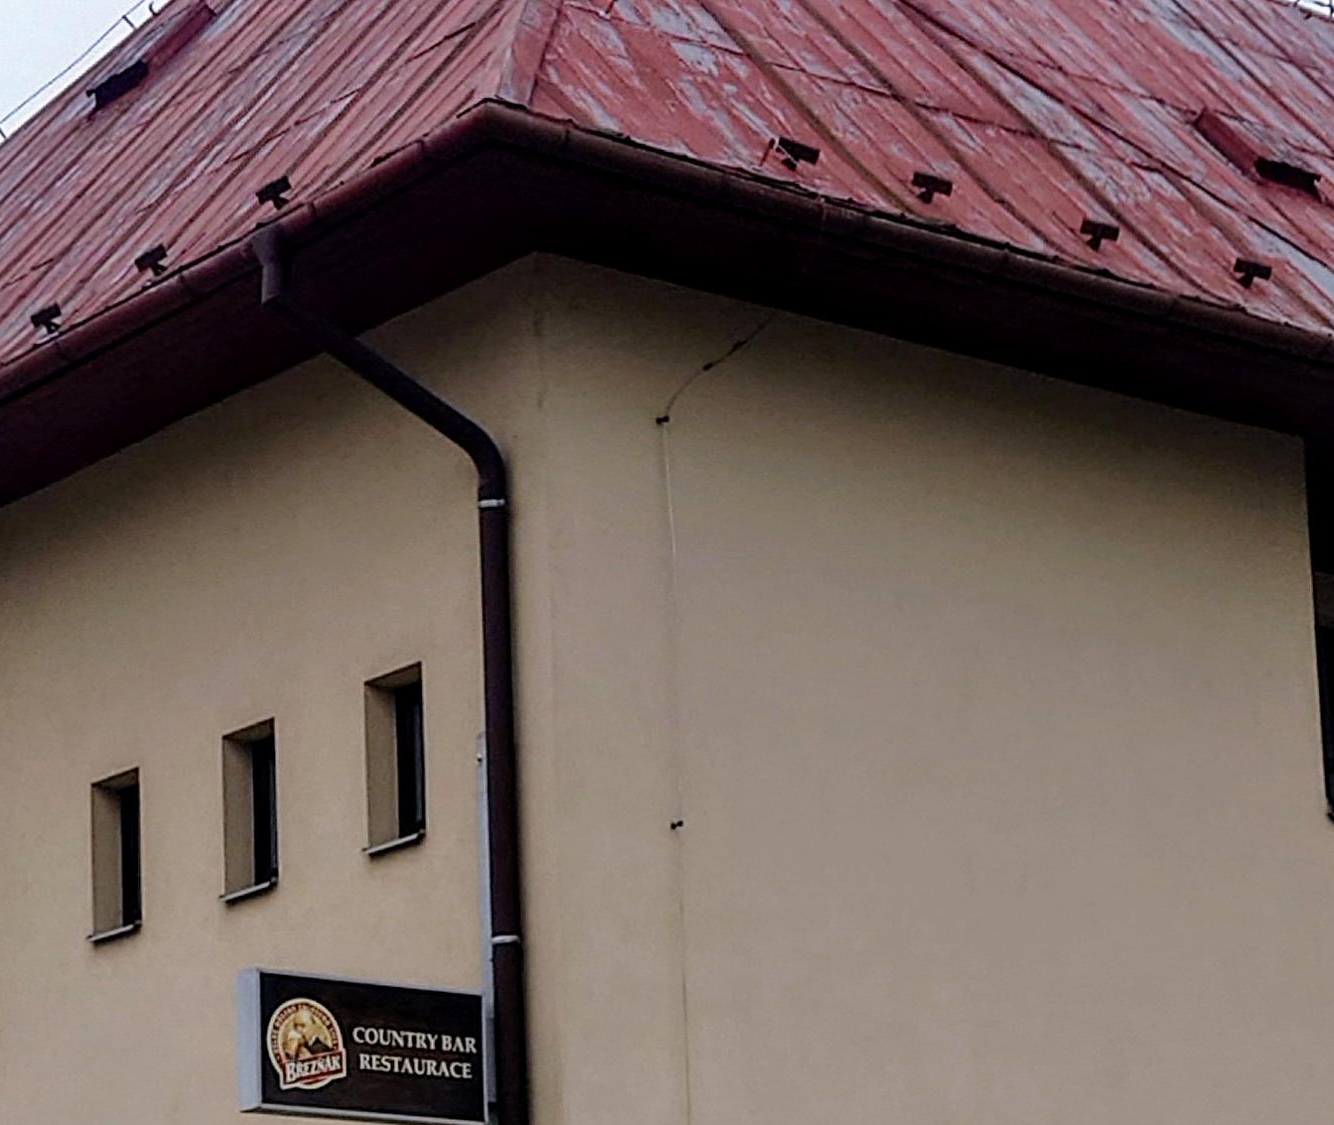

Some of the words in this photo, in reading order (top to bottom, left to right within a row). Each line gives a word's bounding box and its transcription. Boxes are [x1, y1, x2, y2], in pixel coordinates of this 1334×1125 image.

[352, 1027, 438, 1050] COUNTRY
[441, 1035, 477, 1053] BAR
[359, 1054, 472, 1079] RESTAURACE
